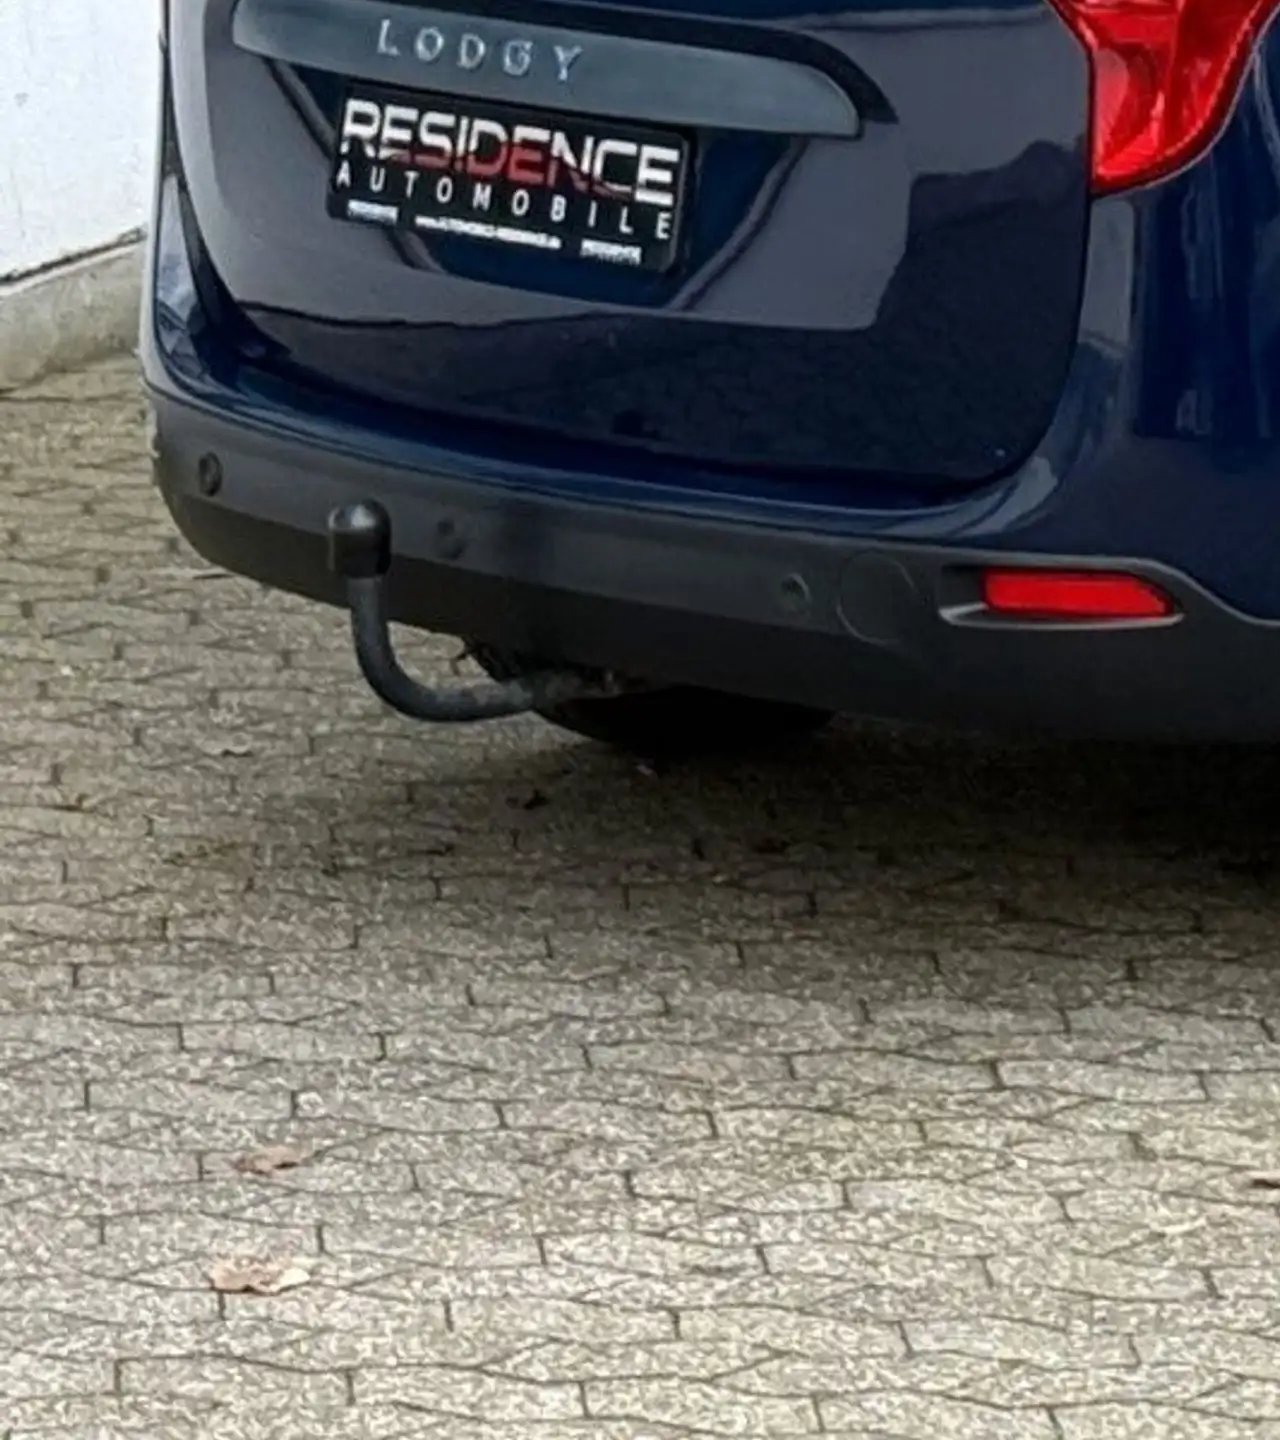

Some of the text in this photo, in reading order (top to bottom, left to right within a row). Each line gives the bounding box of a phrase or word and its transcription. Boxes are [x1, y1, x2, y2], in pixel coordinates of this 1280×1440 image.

[376, 18, 582, 80] LODGY
[340, 99, 680, 206] RESIDENCE
[336, 161, 672, 240] AUTOMOBILE
